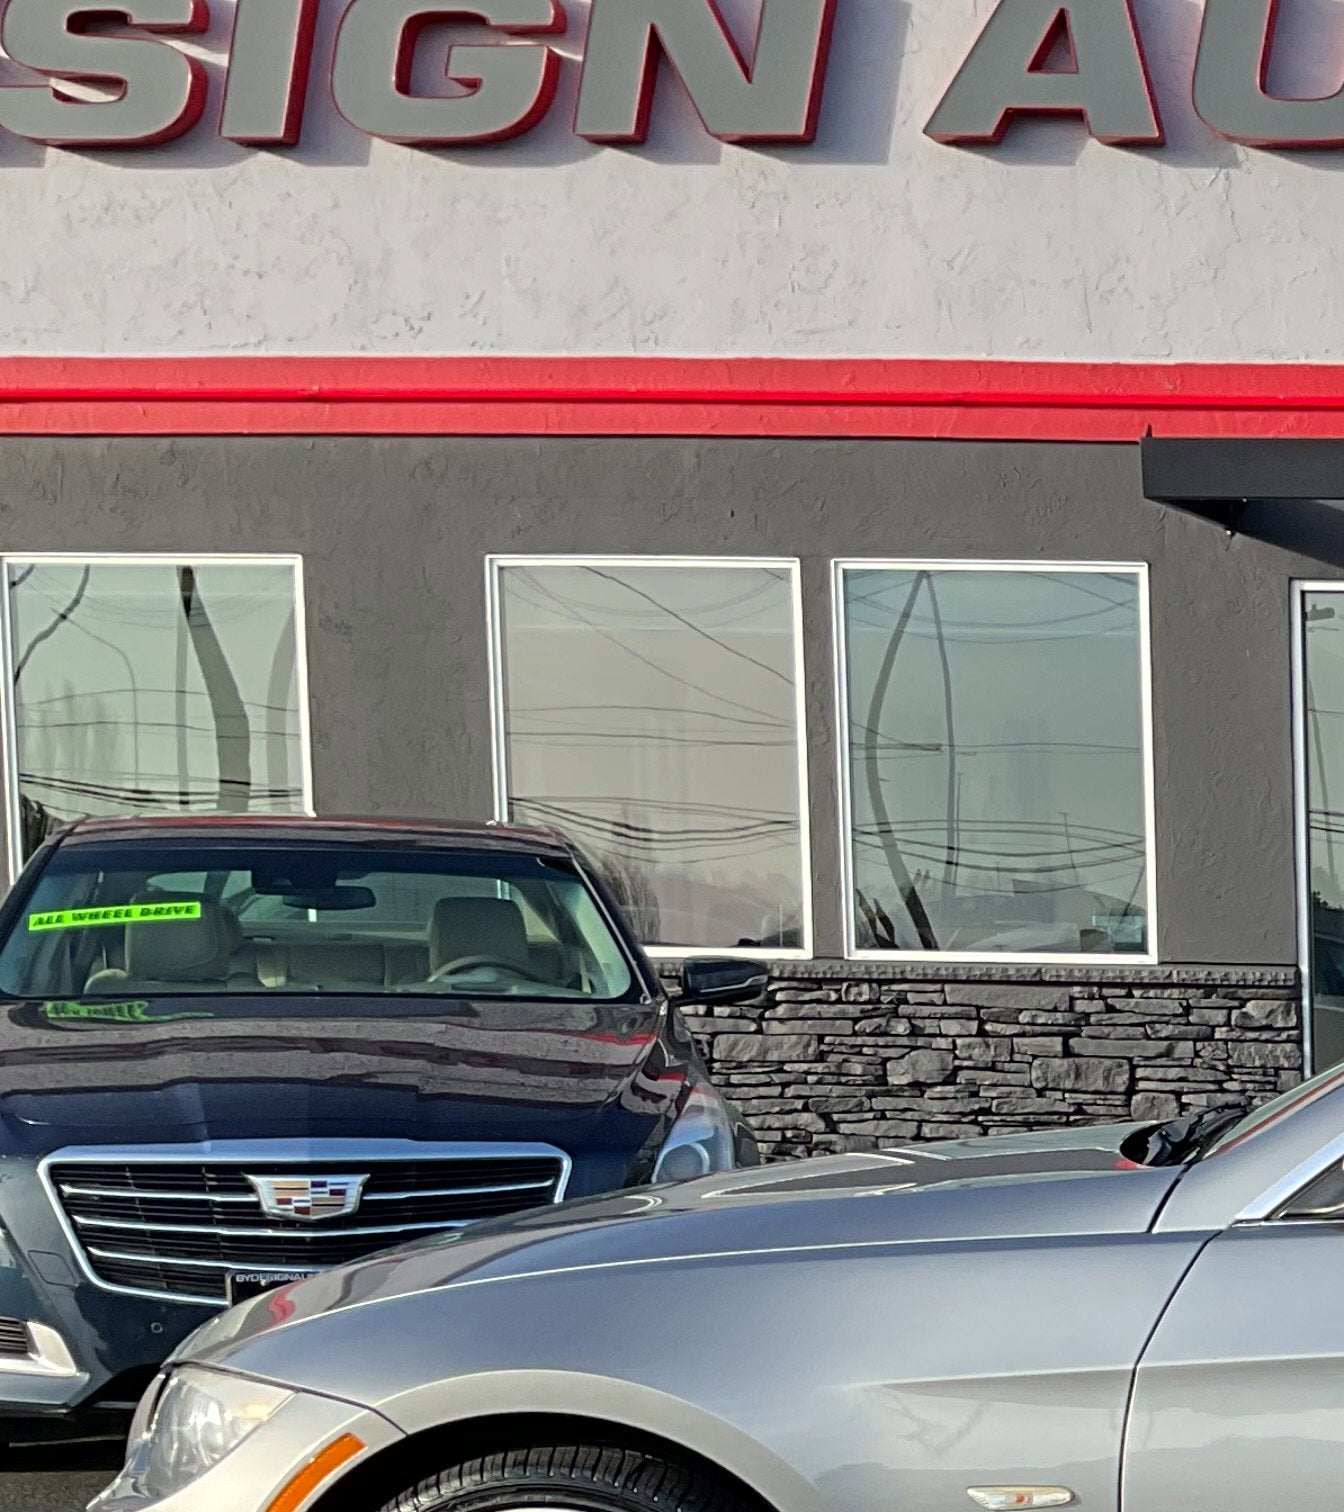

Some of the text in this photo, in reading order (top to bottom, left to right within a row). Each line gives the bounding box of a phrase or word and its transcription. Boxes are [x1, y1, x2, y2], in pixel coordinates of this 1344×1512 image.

[32, 904, 196, 927] ALL WHEEL DRIVE
